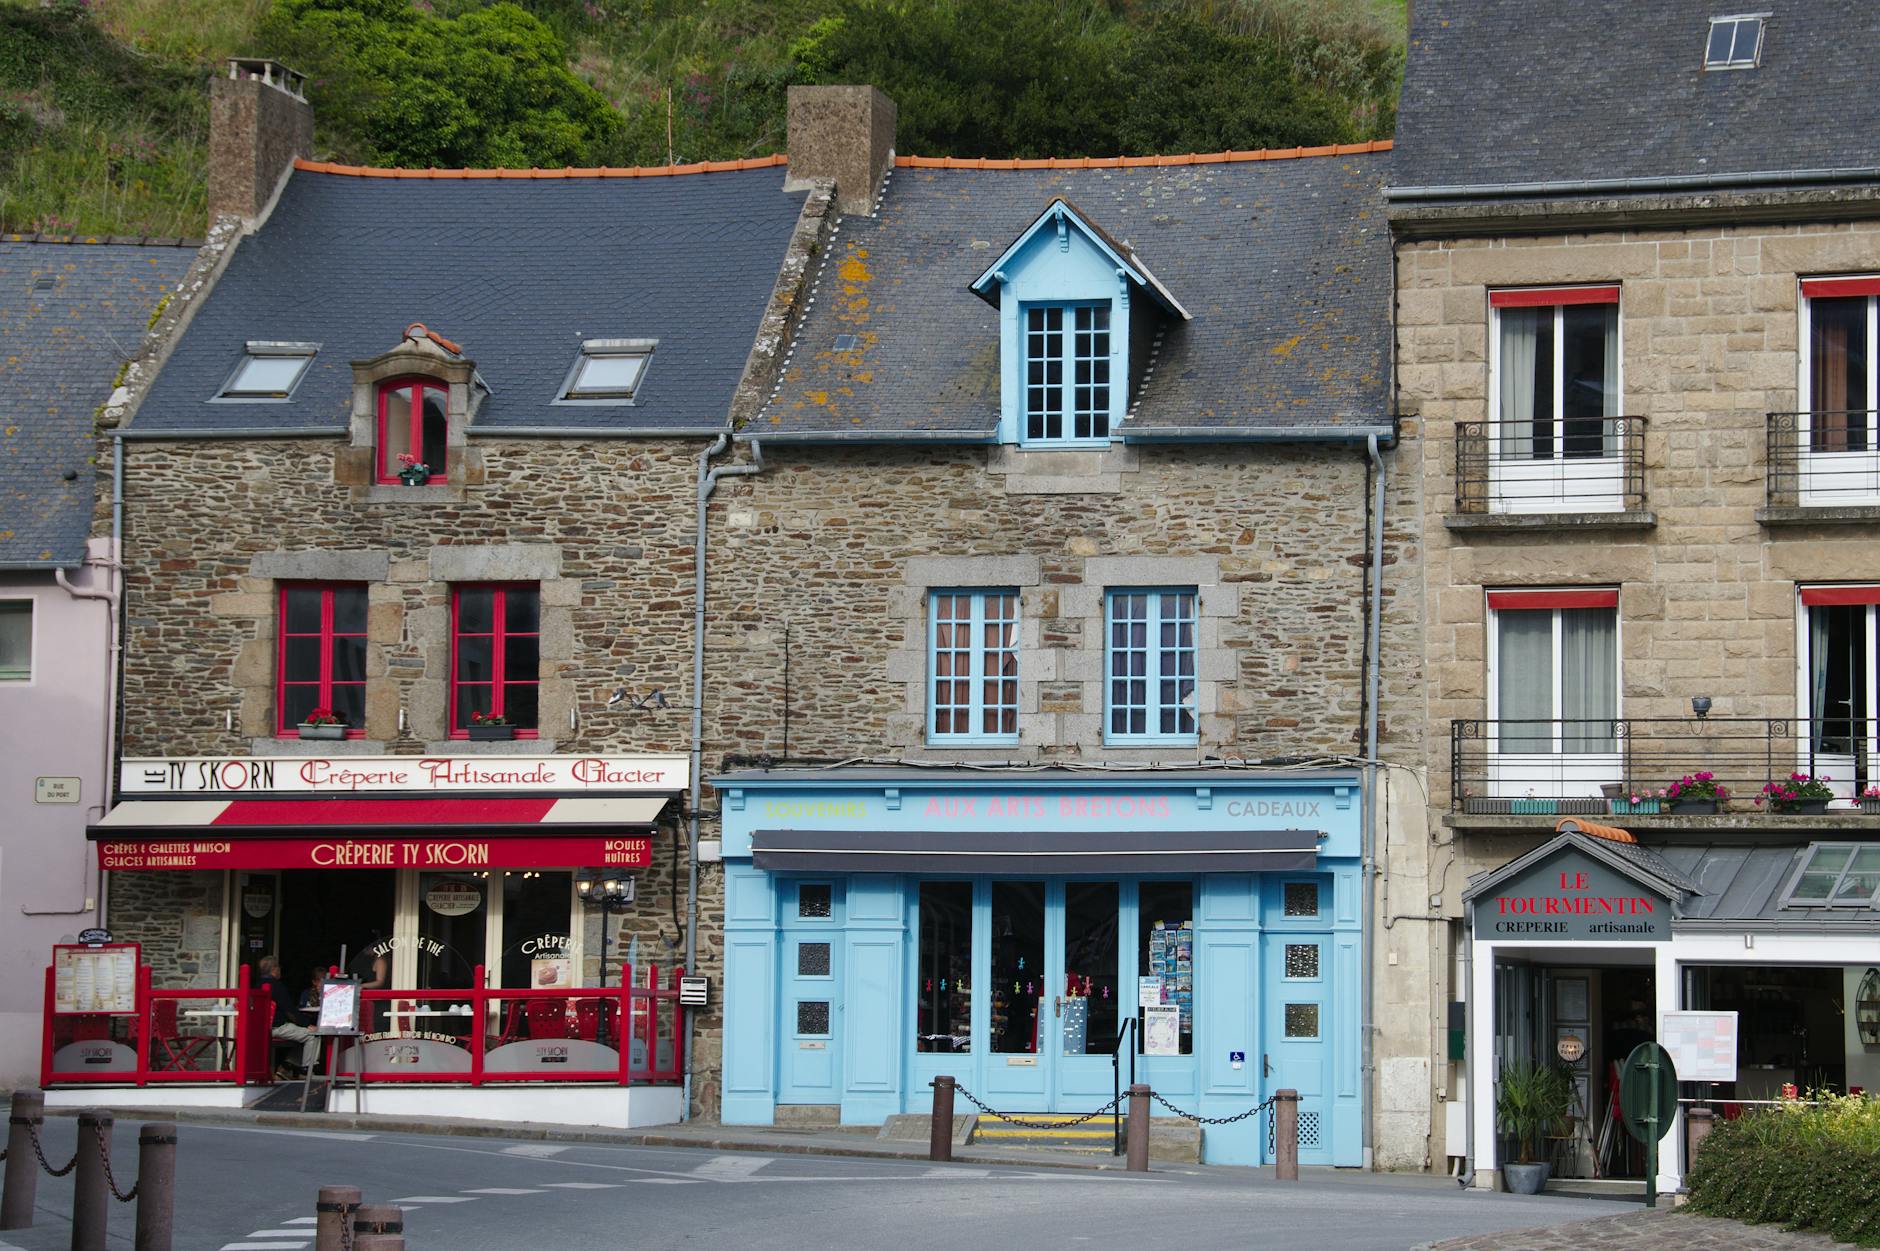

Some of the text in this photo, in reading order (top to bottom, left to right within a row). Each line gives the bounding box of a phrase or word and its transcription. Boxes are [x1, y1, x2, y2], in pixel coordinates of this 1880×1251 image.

[143, 761, 275, 790] LE TY SKORN
[300, 758, 666, 790] Crêperie Artisanale Glacier
[766, 801, 866, 818] SOUVENIRS
[924, 796, 1171, 818] AUX ARTS BRETONS
[1226, 800, 1321, 818] CADEAUX
[103, 843, 138, 855] CRÊPES
[148, 843, 191, 854] GALETTES
[193, 842, 232, 854] MAISON
[311, 840, 489, 865] CRÊPERIE TY SKORN
[605, 840, 646, 851] MOULES
[103, 856, 197, 867] GLACES ARTISANALES
[605, 851, 641, 863] HUÎTRES
[1559, 871, 1590, 890] LE
[1494, 896, 1655, 915] TOURMENTIN
[1495, 921, 1656, 934] CREPERIE artisanale
[373, 937, 446, 958] SALON DE THÉ
[521, 933, 584, 954] CRÊPERIE
